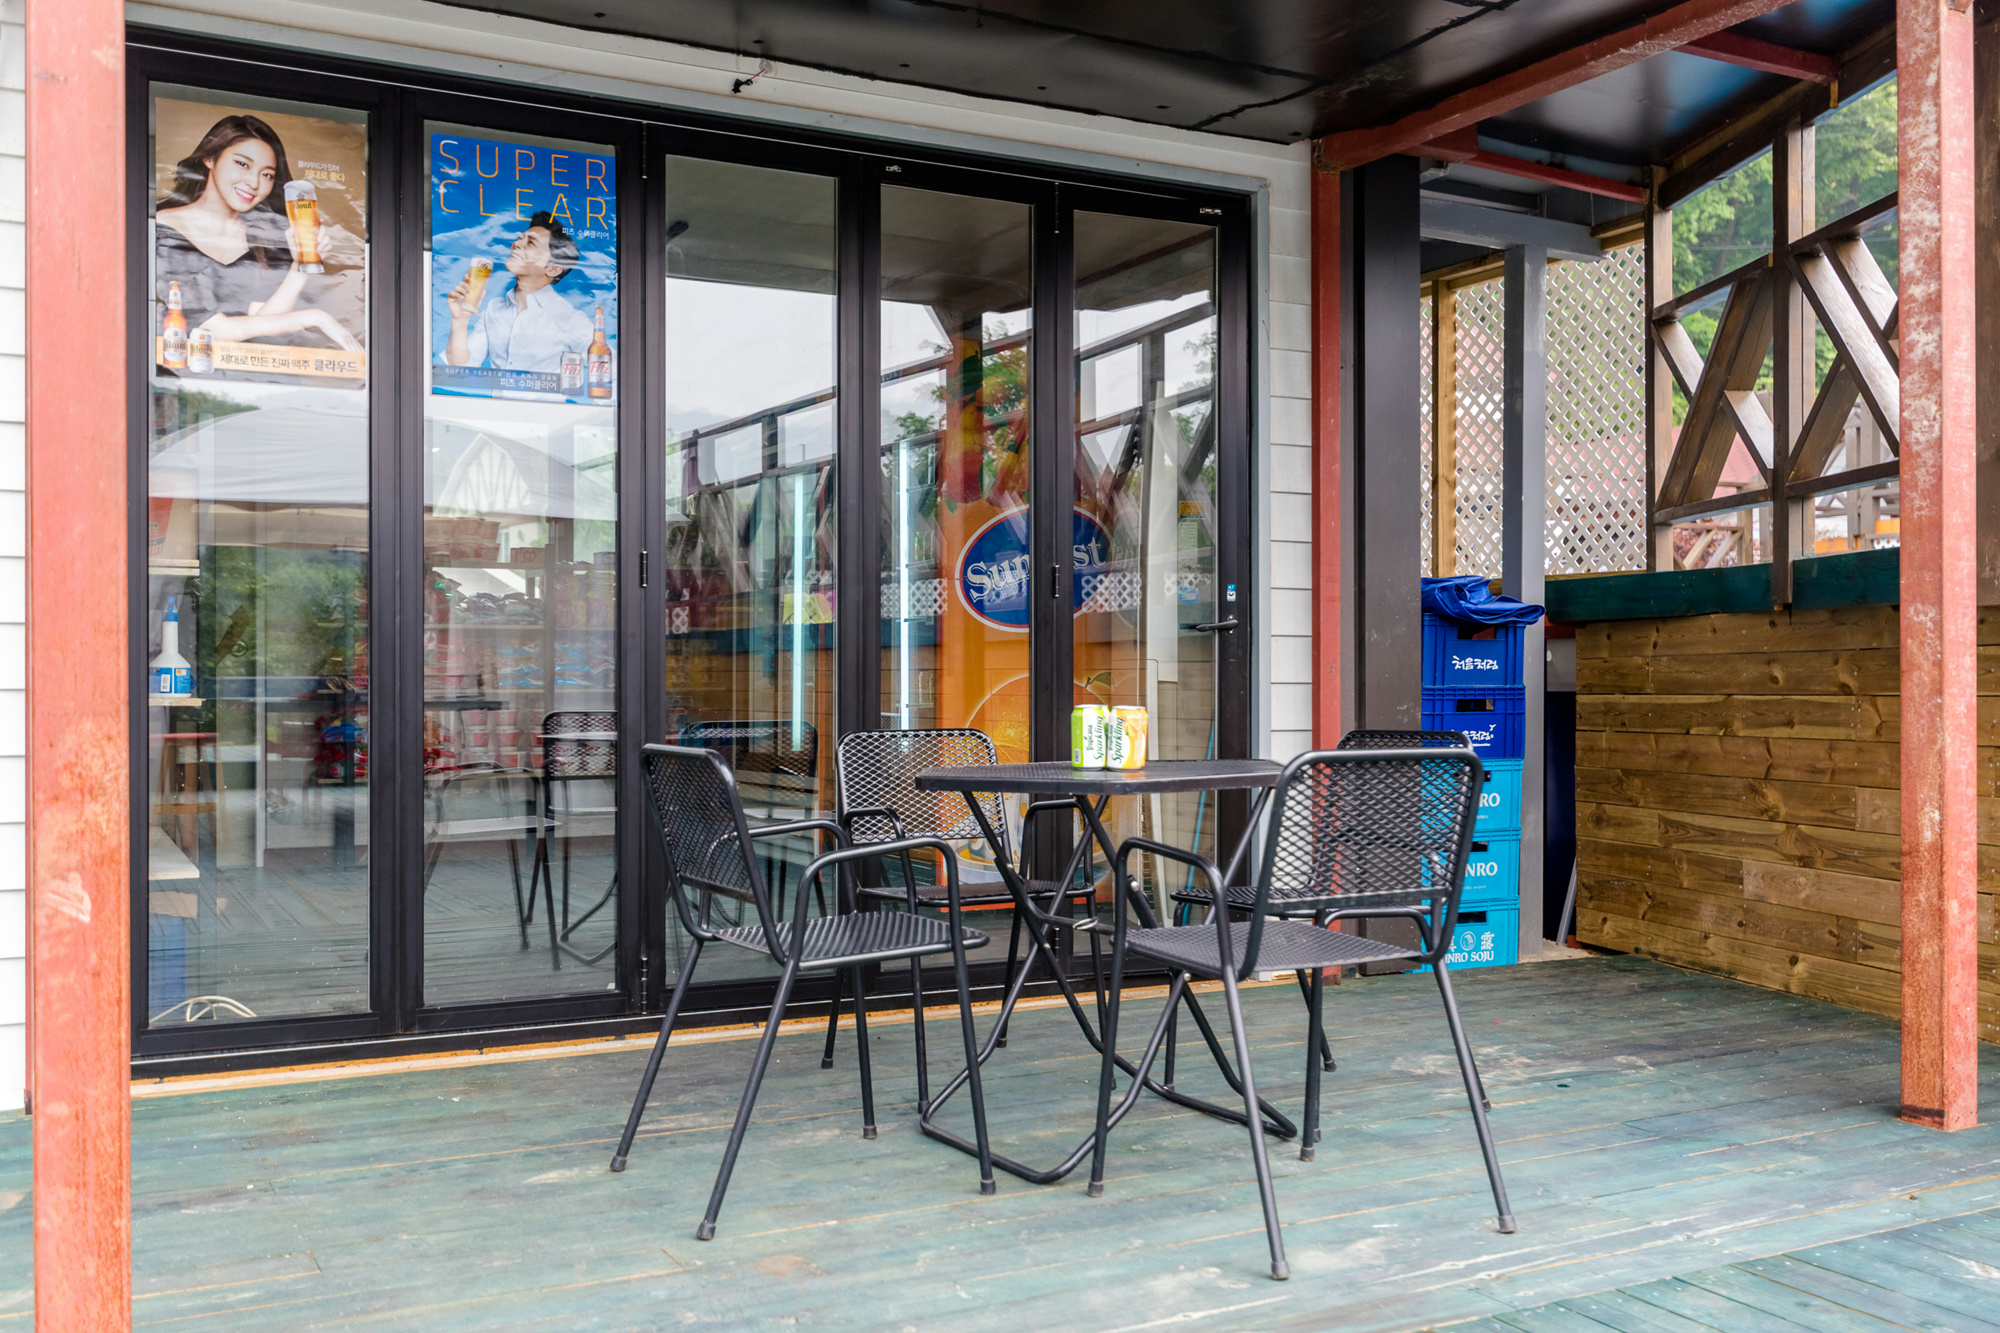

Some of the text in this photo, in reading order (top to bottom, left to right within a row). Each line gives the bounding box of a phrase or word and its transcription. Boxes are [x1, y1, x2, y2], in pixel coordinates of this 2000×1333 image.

[440, 140, 608, 192] SUPER
[440, 179, 608, 229] CLEAR
[561, 226, 576, 236] 피츠
[220, 353, 359, 373] 제대로 만든 진짜 맥주 클라우드
[562, 363, 581, 376] Fitz
[589, 360, 609, 375] Fitz
[445, 367, 470, 375] SUPER
[500, 378, 557, 391] 피츠 수퍼클리어
[966, 537, 1106, 603] Sunst
[1452, 655, 1498, 670] 처음처럼
[1093, 715, 1105, 762] Sparkling
[1111, 716, 1126, 764] Sparkling
[1465, 862, 1498, 878] NRO
[1445, 950, 1494, 963] INRO SOJU
